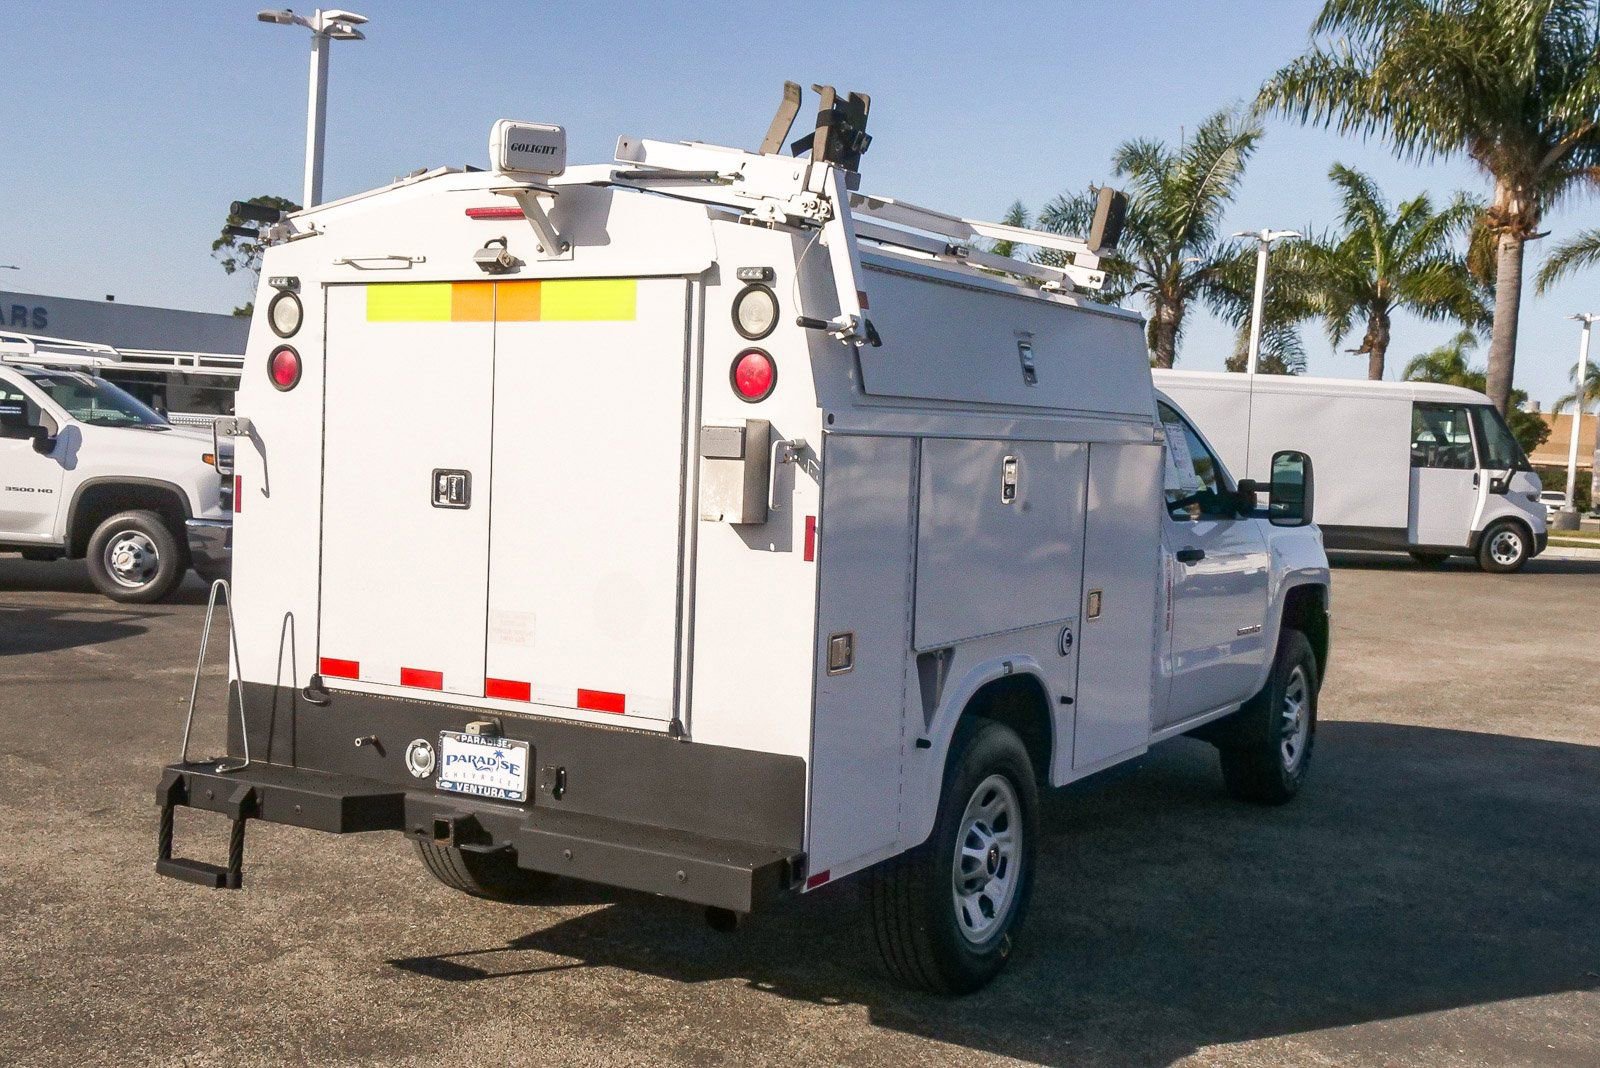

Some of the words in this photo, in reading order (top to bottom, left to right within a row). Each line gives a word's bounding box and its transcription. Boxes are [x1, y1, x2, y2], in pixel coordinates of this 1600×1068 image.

[511, 142, 557, 155] GOLIGHT
[461, 735, 508, 748] PARADISE
[446, 751, 521, 777] PARADISE
[445, 772, 521, 789] CHEVROLET
[456, 782, 506, 798] VENTURA
